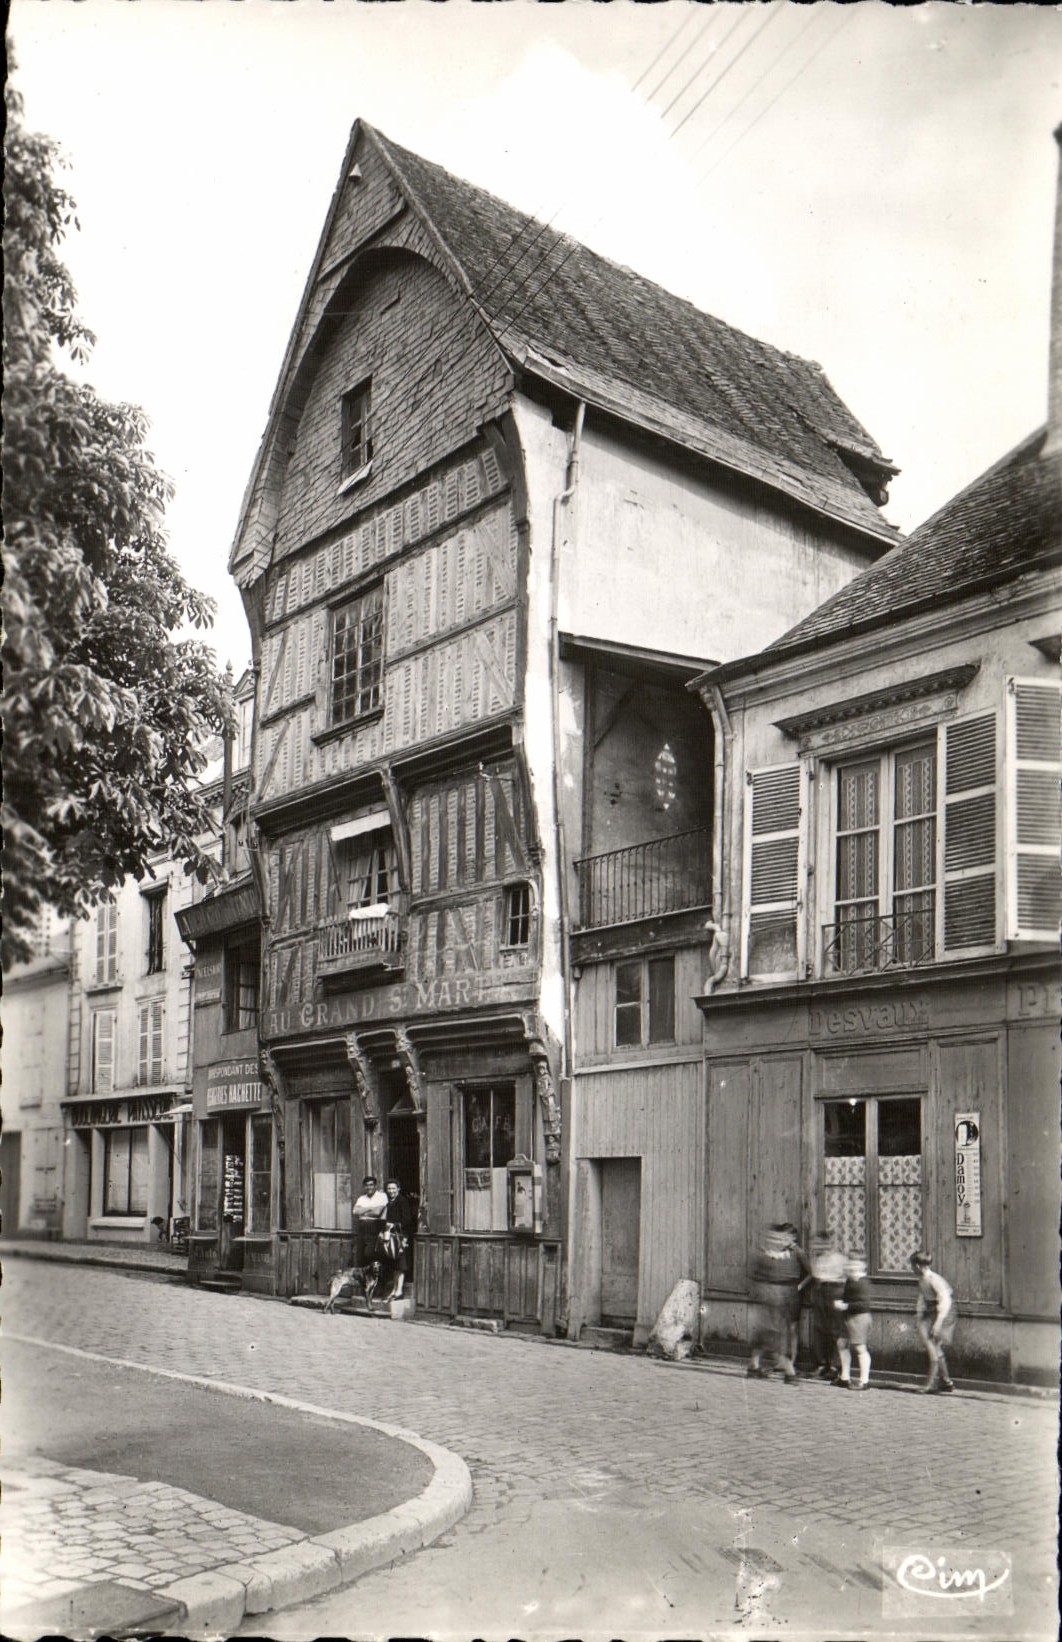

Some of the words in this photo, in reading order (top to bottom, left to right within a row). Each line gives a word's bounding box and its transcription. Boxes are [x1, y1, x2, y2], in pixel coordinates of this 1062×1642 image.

[269, 1010, 291, 1035] AU
[300, 994, 376, 1028] GRAND
[245, 1063, 259, 1075] DES
[229, 1082, 262, 1104] HACHETTE
[957, 1152, 966, 1207] Damoy
